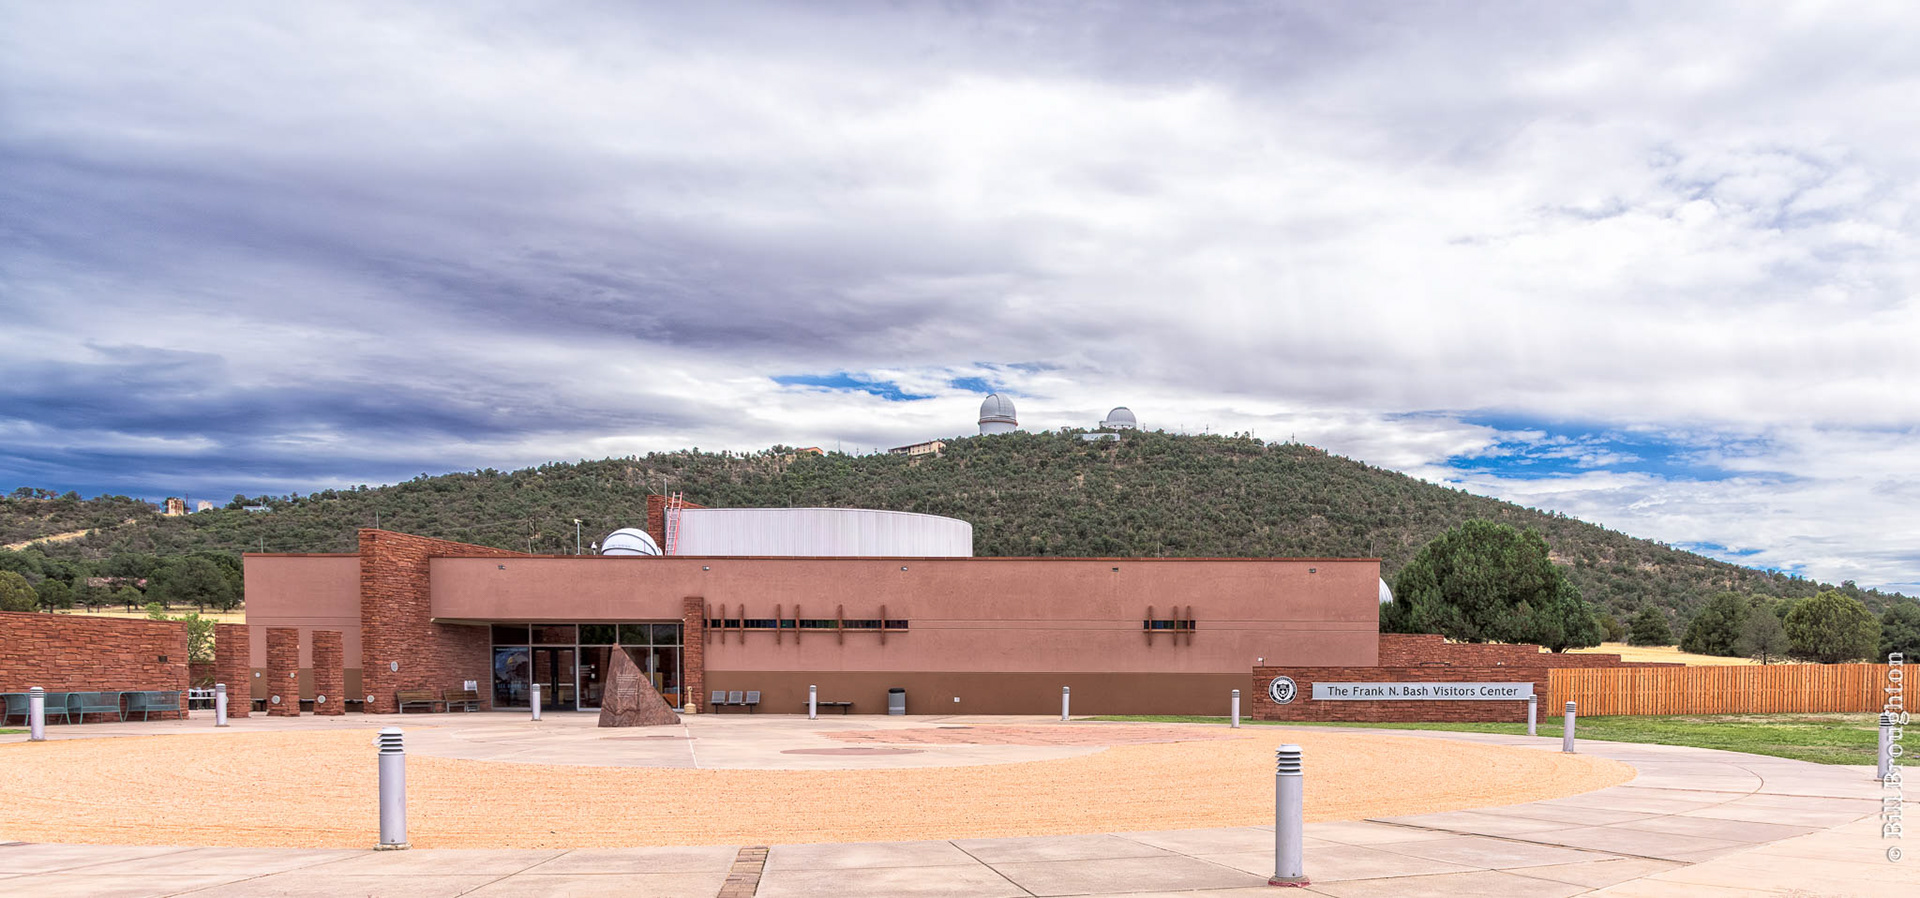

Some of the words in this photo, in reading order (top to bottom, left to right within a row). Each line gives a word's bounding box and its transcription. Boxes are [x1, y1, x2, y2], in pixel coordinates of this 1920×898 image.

[1327, 686, 1349, 696] The
[1353, 686, 1384, 696] Frank
[1388, 686, 1400, 696] N.
[1403, 686, 1428, 696] Bash
[1433, 686, 1475, 696] Visitors
[1480, 686, 1518, 696] Center
